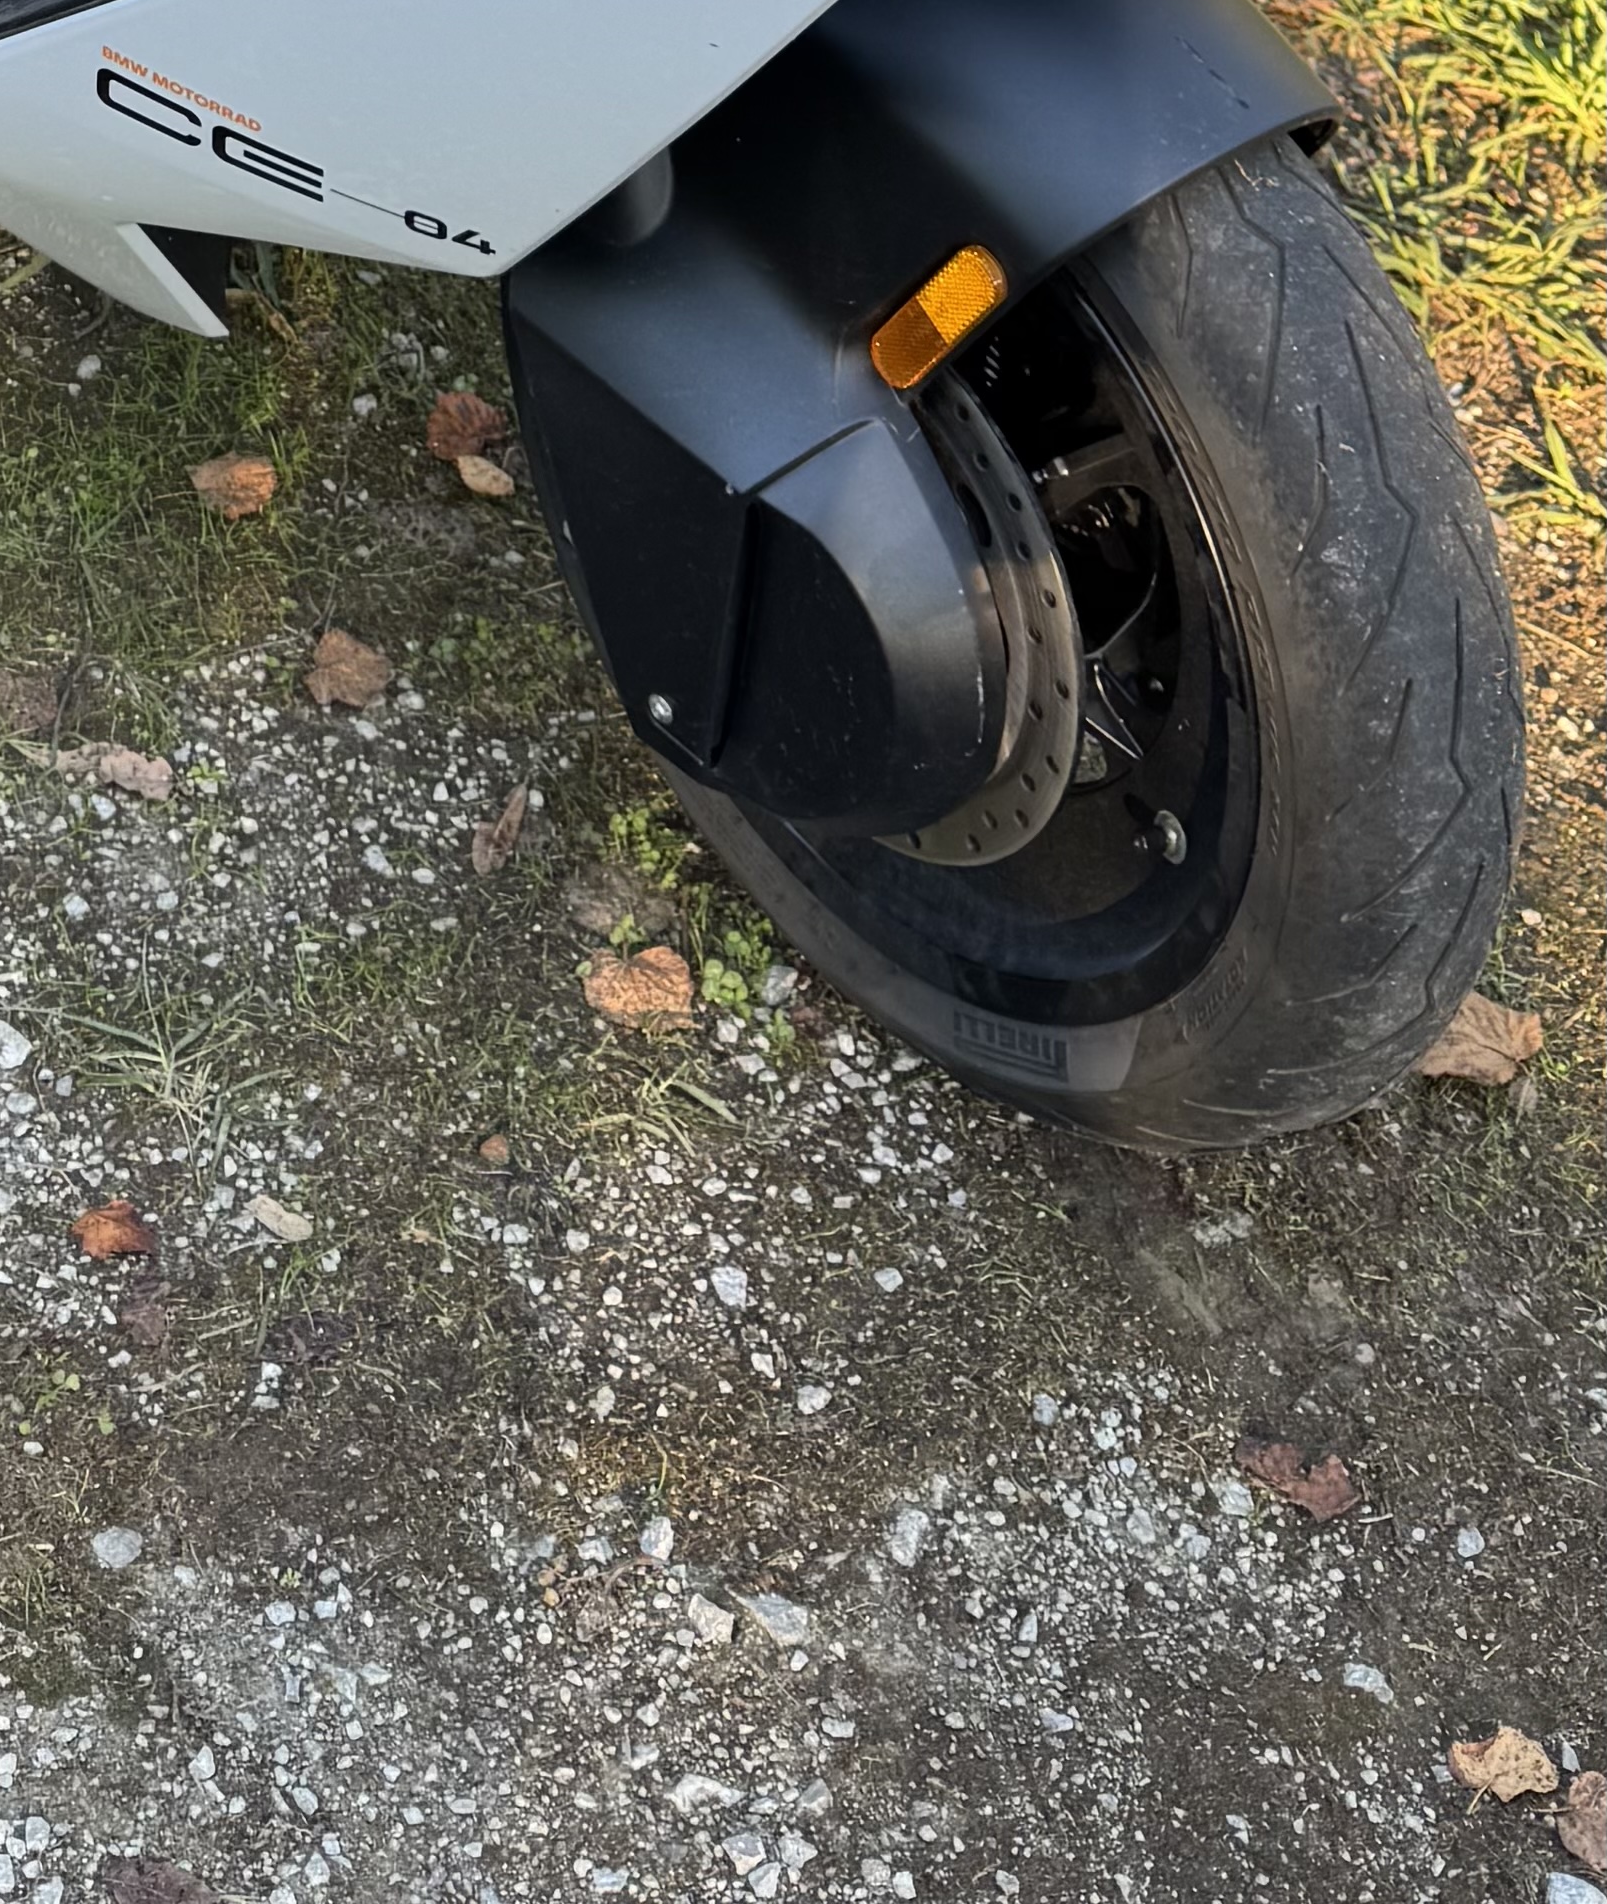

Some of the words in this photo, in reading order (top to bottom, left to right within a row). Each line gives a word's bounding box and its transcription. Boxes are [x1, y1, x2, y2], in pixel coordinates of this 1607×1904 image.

[96, 67, 324, 203] CE
[101, 45, 149, 77] BMW
[152, 72, 262, 133] MOTORRAD
